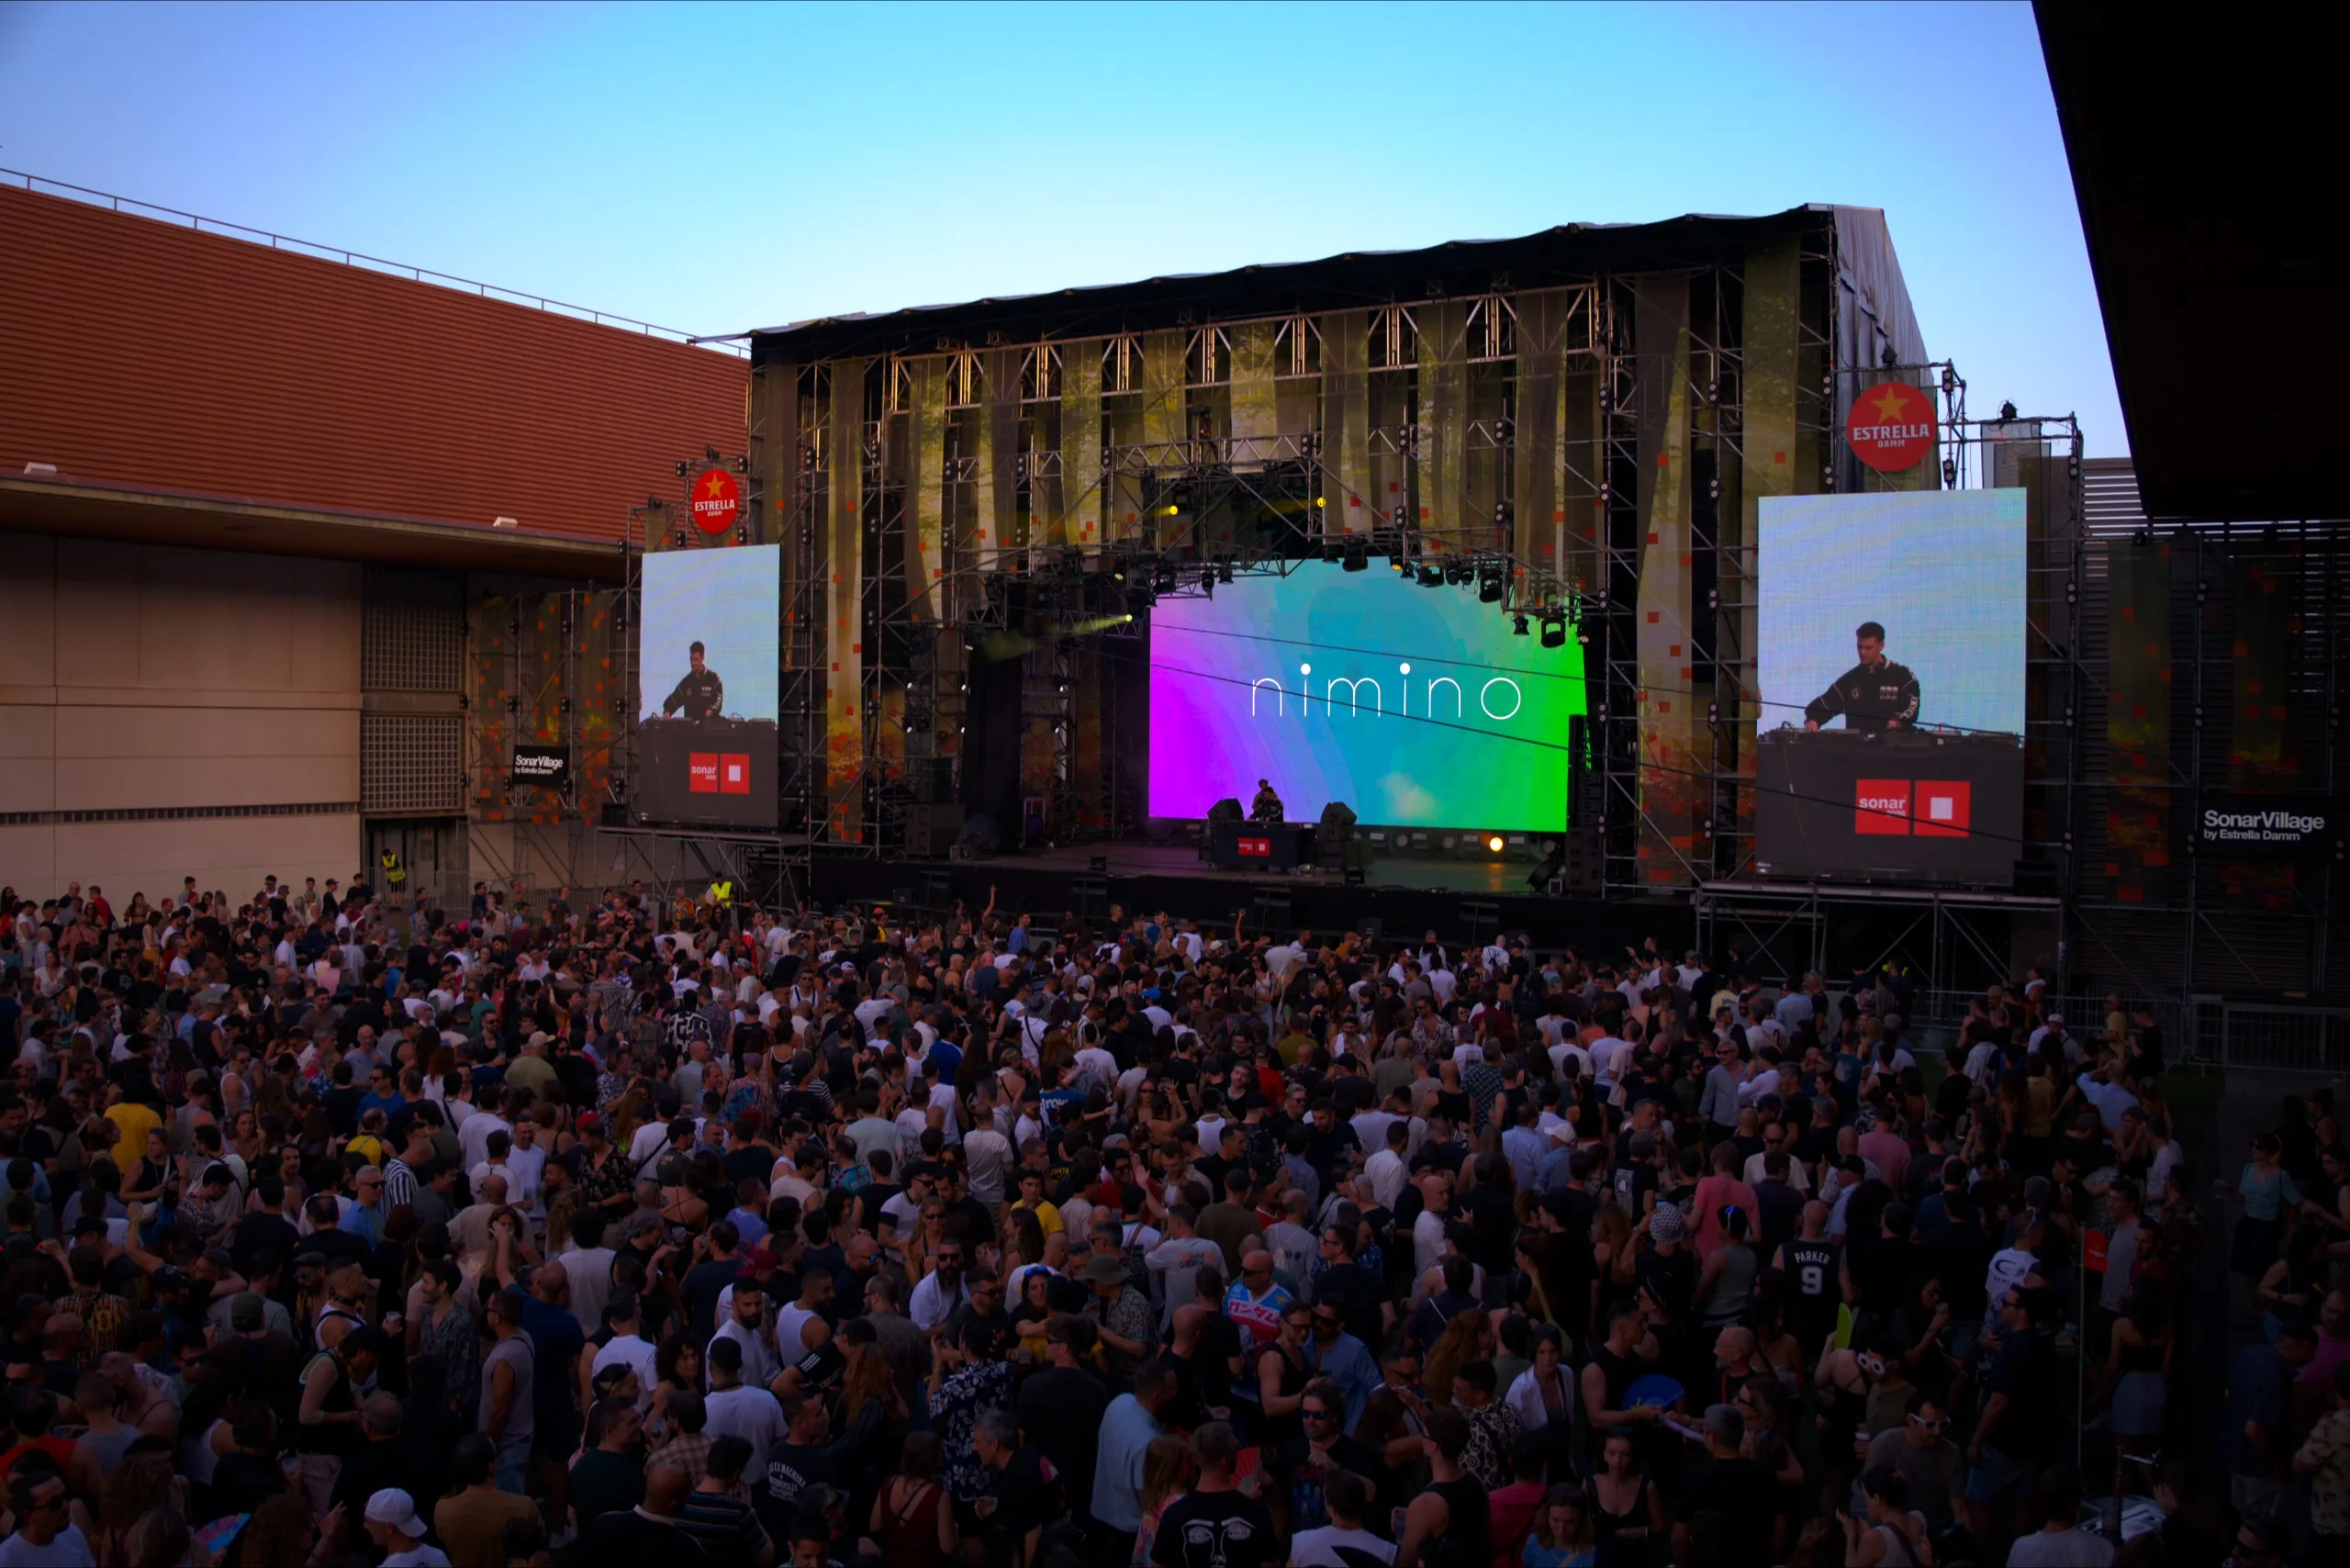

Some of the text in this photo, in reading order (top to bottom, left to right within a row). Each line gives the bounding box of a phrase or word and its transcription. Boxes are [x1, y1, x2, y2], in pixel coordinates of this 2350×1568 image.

[1852, 423, 1930, 442] ESTRELLA
[1877, 440, 1906, 449] DAMM
[694, 498, 735, 512] ESTRELLA
[1252, 663, 1521, 720] nimino
[515, 754, 564, 770] SonarVillage
[2204, 809, 2325, 834] SonarVillage
[2203, 828, 2301, 842] by Estrella Damm
[1794, 1249, 1830, 1265] PARKER
[1800, 1265, 1823, 1296] 9
